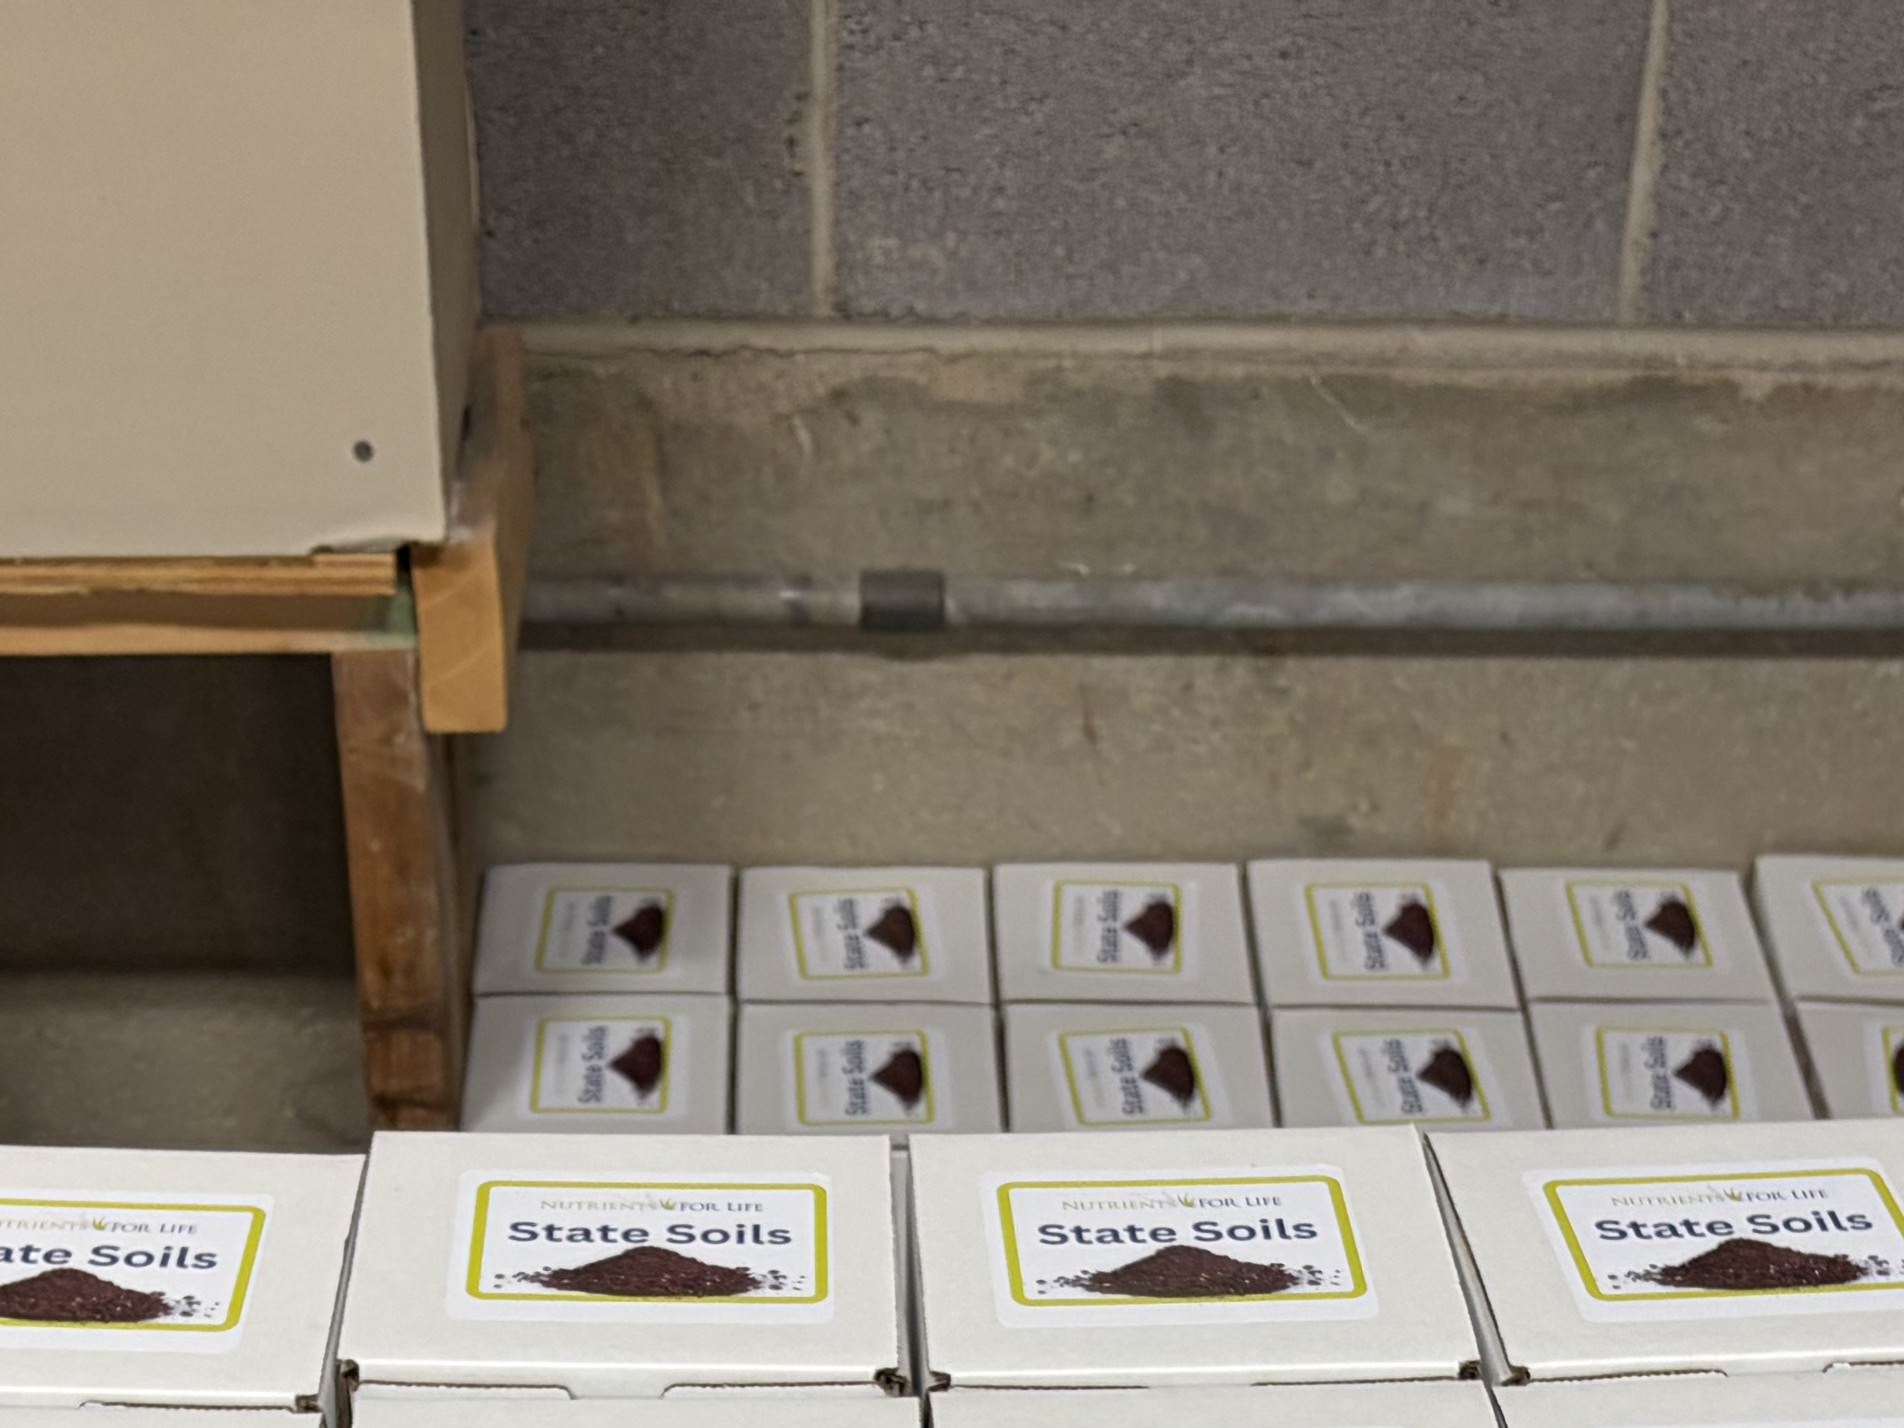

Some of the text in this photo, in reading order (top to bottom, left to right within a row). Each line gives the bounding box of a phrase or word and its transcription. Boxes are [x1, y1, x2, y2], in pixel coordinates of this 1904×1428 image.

[508, 1221, 791, 1245] State Soils
[1039, 1218, 1318, 1245] State Soils
[1596, 1210, 1874, 1241] State Soils
[89, 1245, 218, 1269] Soils
